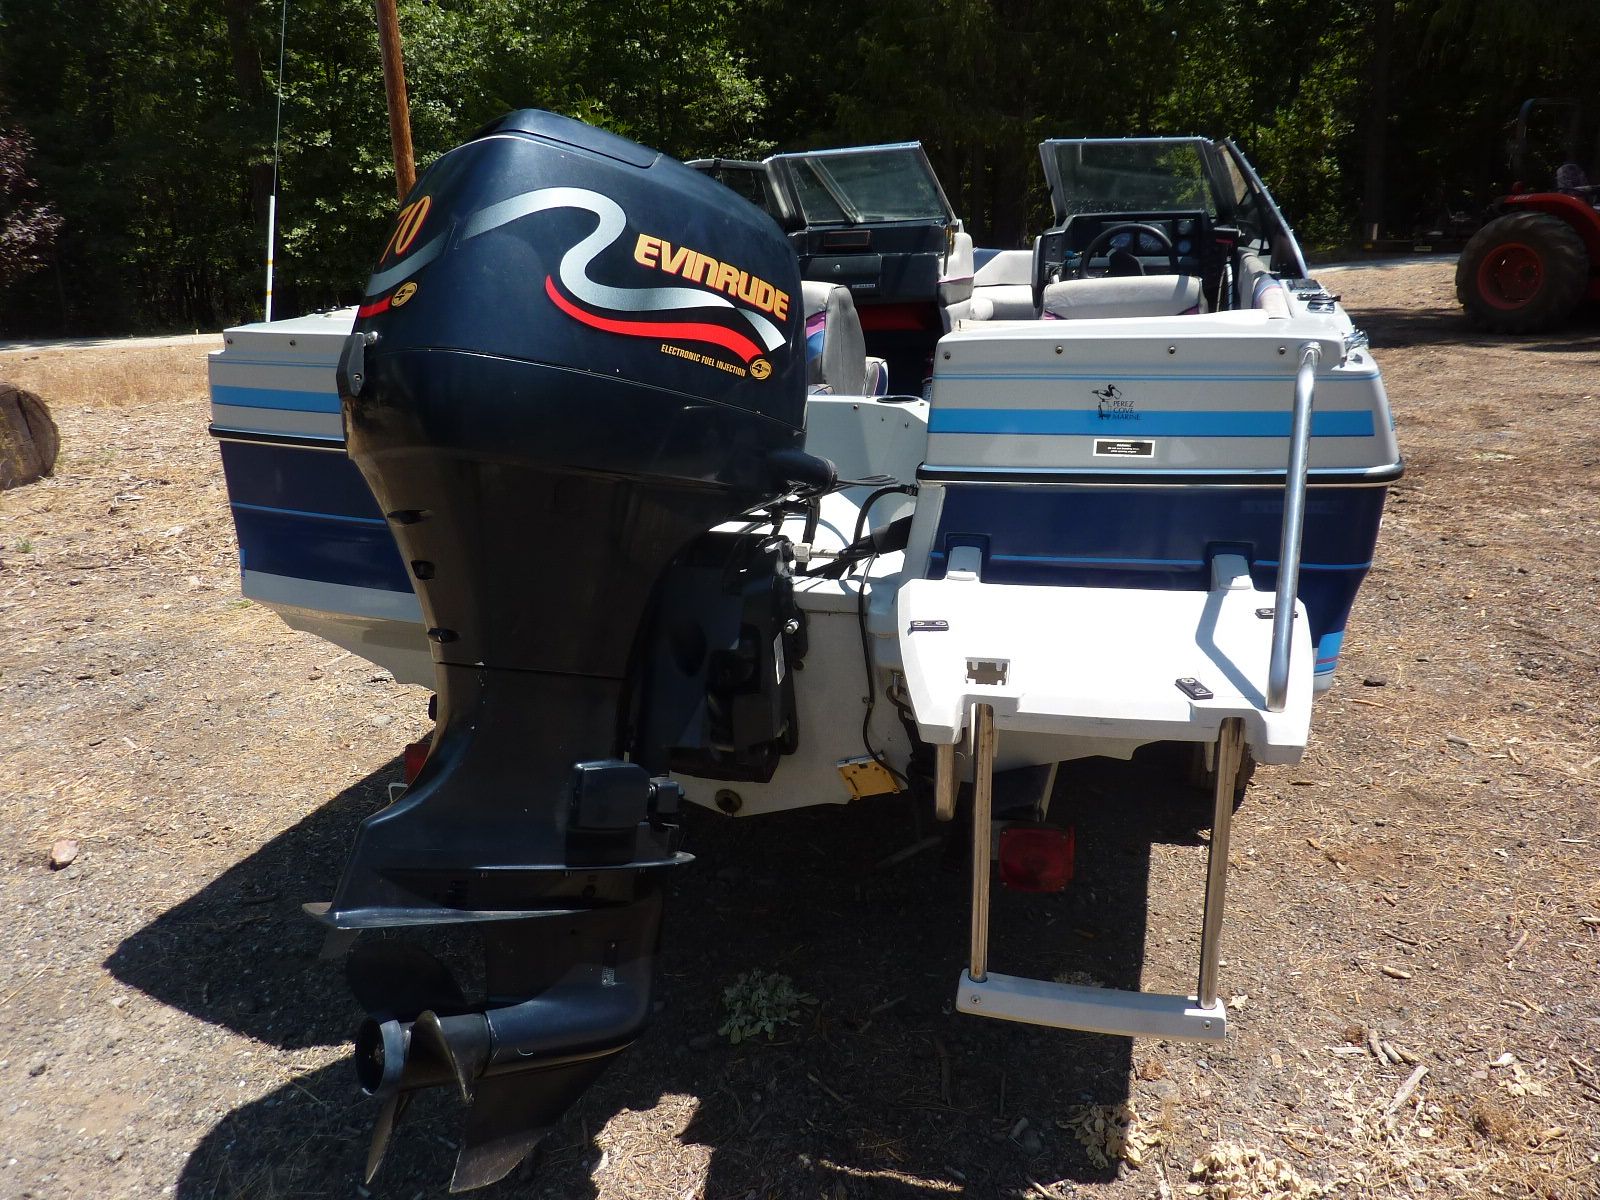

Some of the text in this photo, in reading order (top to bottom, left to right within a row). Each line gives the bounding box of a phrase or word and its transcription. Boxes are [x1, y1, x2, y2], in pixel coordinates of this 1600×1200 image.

[379, 195, 431, 264] 70
[633, 233, 790, 322] EVINRUDE
[660, 344, 747, 377] ELECTRONIC FUEL INJECTION
